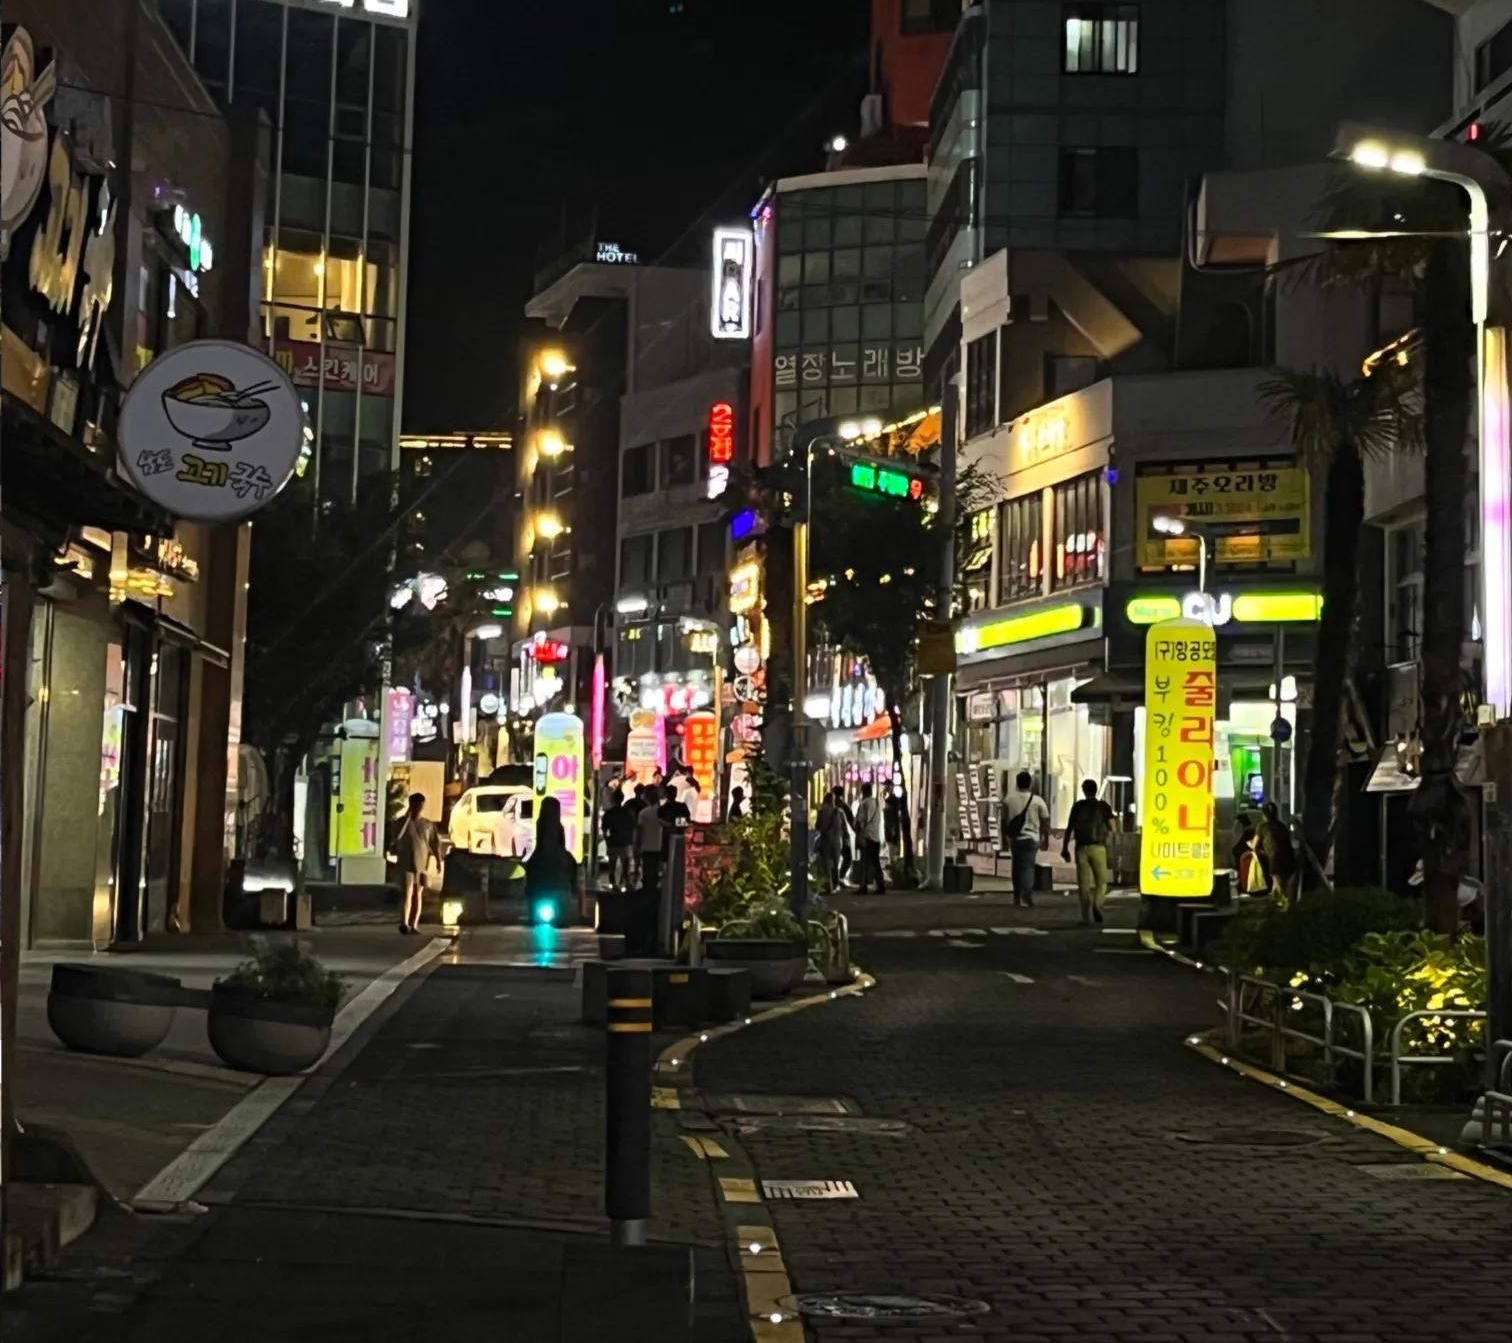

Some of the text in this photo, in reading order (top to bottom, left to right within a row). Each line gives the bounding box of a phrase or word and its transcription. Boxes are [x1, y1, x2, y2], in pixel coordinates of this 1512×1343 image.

[597, 242, 619, 252] THE
[597, 251, 640, 263] HOTEL
[302, 356, 378, 384] 스킨케어
[1183, 592, 1231, 625] CU
